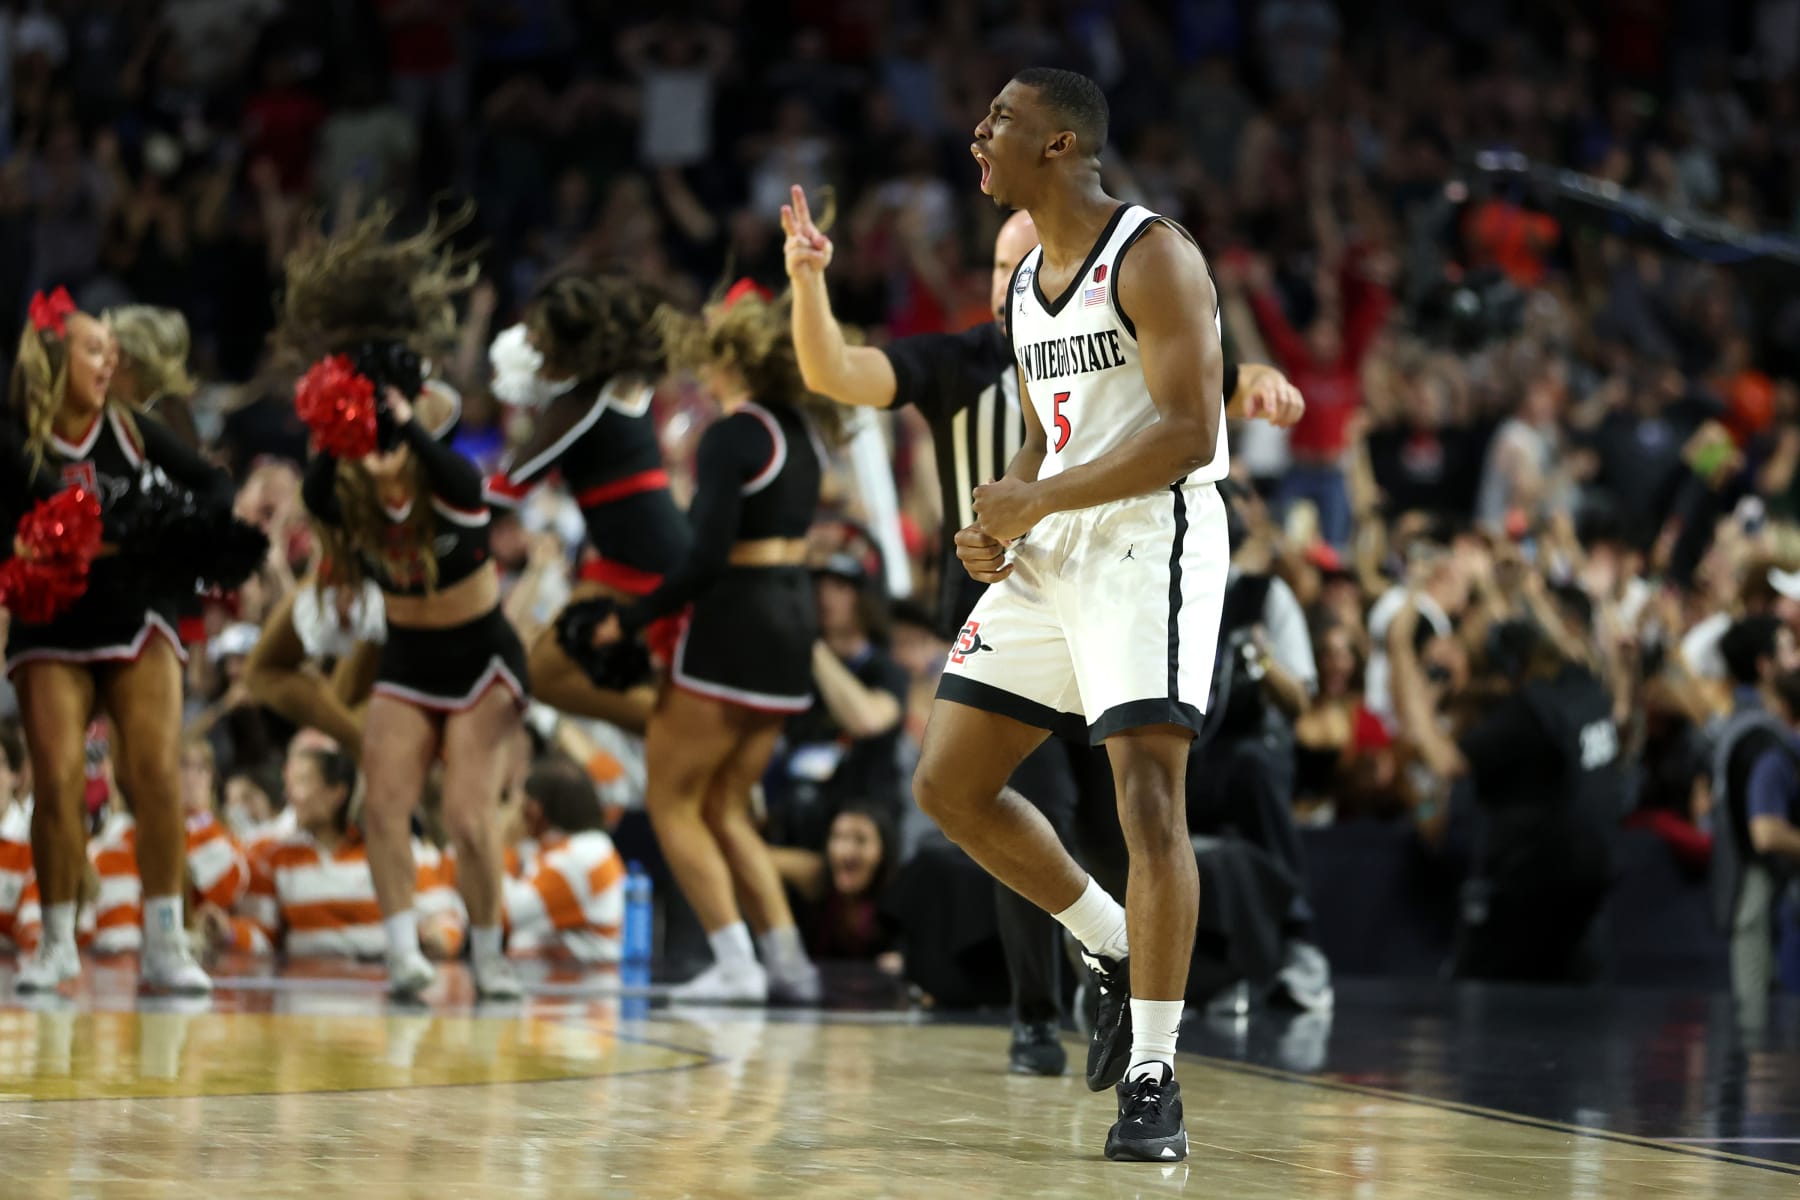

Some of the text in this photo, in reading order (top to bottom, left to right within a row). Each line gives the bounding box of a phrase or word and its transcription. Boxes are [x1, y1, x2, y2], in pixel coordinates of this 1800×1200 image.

[1034, 337, 1070, 381] DIEGO
[1070, 329, 1126, 373] STATE
[1053, 391, 1072, 454] 5
